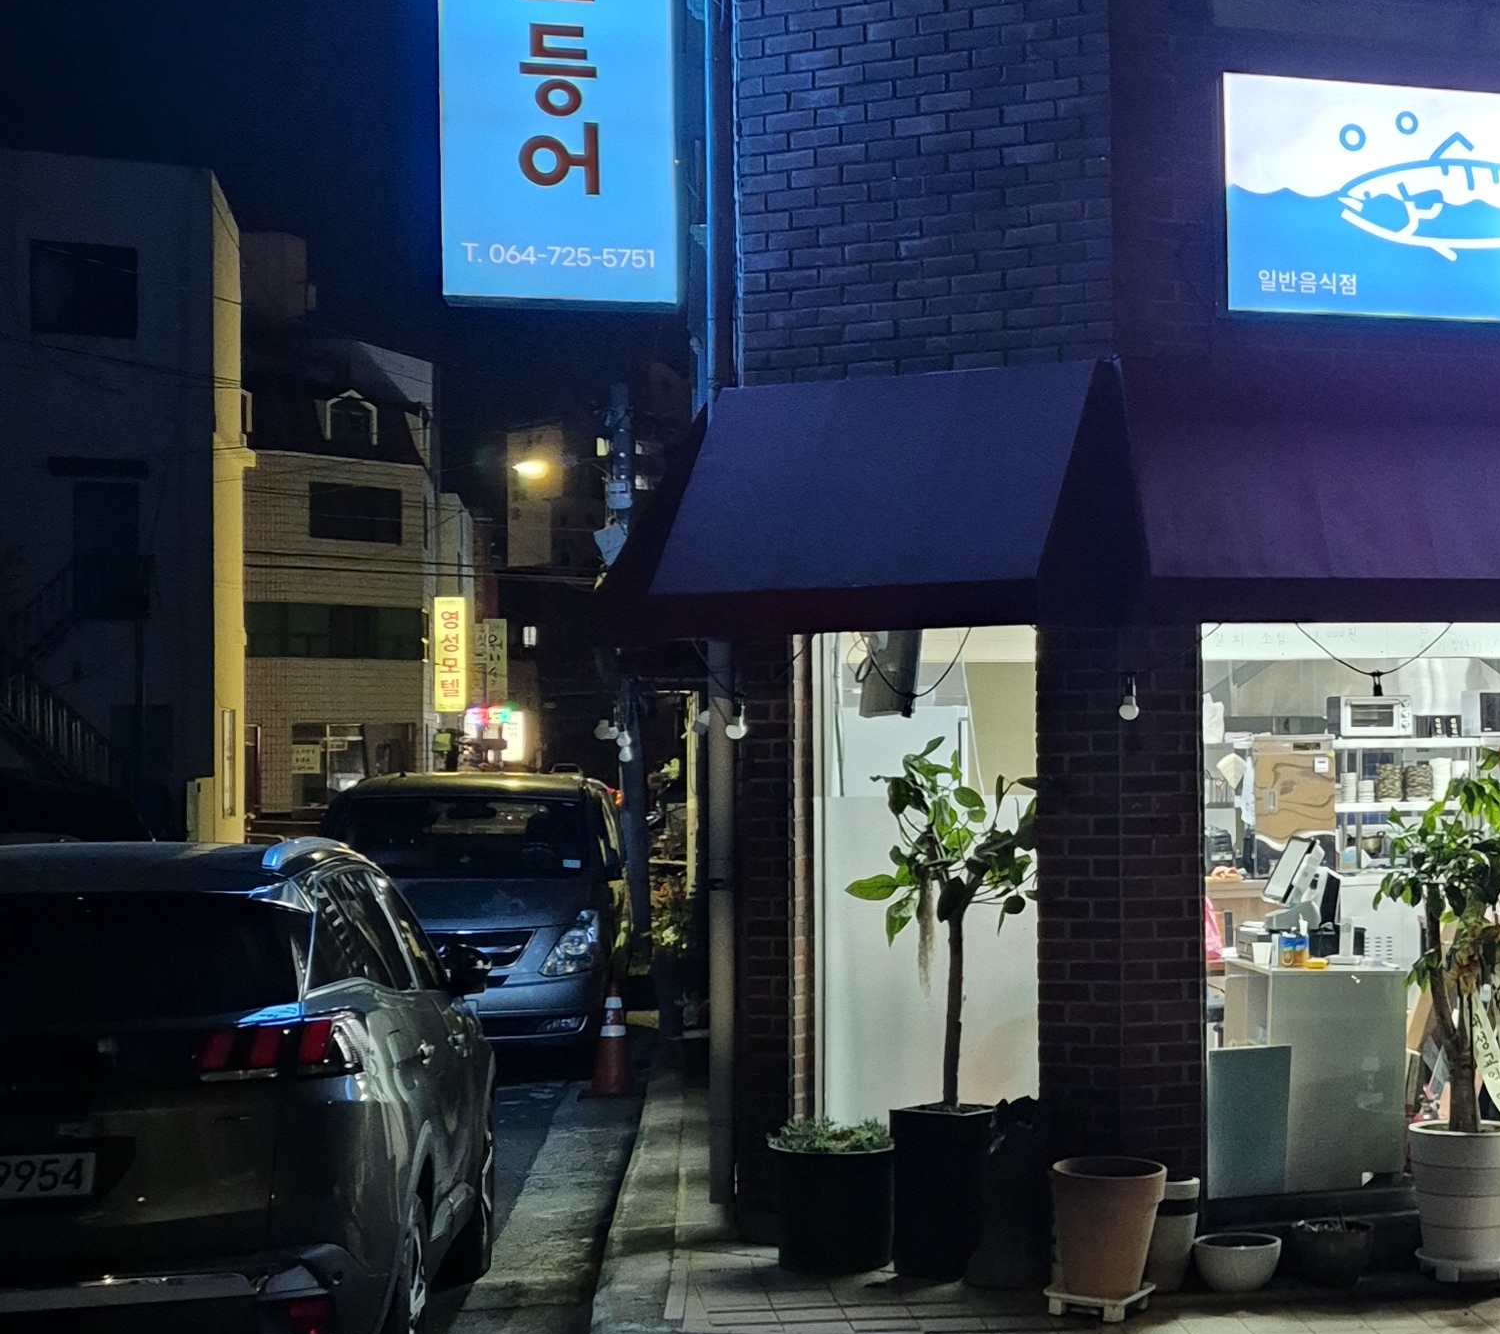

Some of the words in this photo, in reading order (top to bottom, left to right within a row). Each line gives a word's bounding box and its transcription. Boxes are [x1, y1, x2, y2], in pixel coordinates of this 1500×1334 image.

[460, 242, 483, 264] T.
[488, 242, 656, 269] 064-725-5751
[1257, 268, 1358, 296] 일반음식점
[440, 610, 461, 698] 영성모텔
